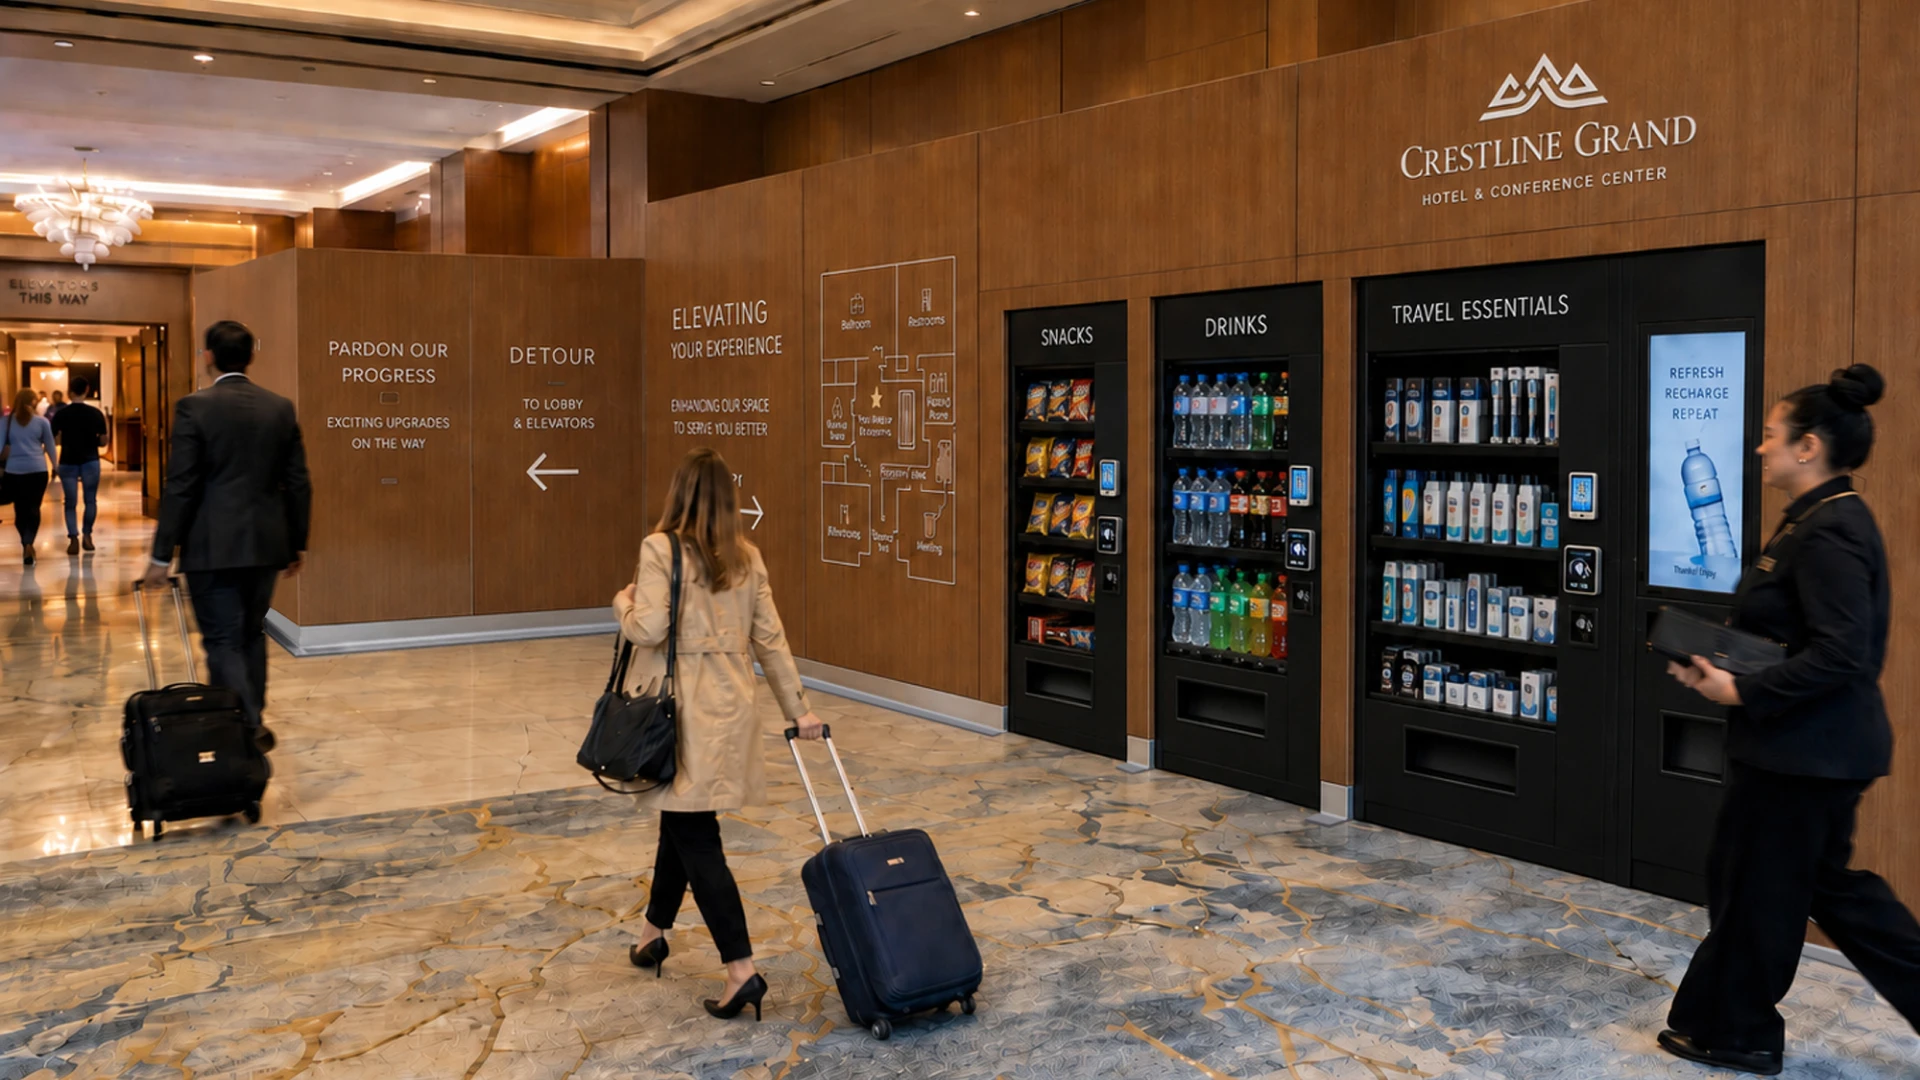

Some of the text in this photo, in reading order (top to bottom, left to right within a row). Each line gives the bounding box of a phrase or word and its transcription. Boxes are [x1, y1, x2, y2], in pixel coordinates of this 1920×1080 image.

[1422, 166, 1668, 206] HOTEL & CONFERENCE CENTER
[9, 279, 99, 292] ELEVATORS
[19, 292, 89, 305] THIS WAY
[673, 299, 768, 331] ELEVATING
[1392, 294, 1570, 325] TRAVEL ESSENTIALS
[1205, 314, 1268, 338] DRINKS
[1041, 326, 1094, 347] SNACKS
[328, 340, 449, 358] PARDON OUR
[671, 335, 783, 359] YOUR EXPERIENCE
[509, 346, 596, 365] DETOUR
[341, 367, 437, 384] PROGRESS
[1669, 366, 1724, 380] REFRESH
[1664, 387, 1730, 400] RECHARGE
[523, 398, 584, 411] TO LOBBY
[671, 398, 770, 413] ENHANCING OUR SPACE
[1672, 408, 1719, 420] REPEAT
[327, 416, 451, 429] EXCITING UPGRADES
[513, 417, 596, 430] & ELEVATORS
[673, 421, 768, 436] TO SERVE YOU BETTER
[351, 437, 427, 450] ON THE WAY
